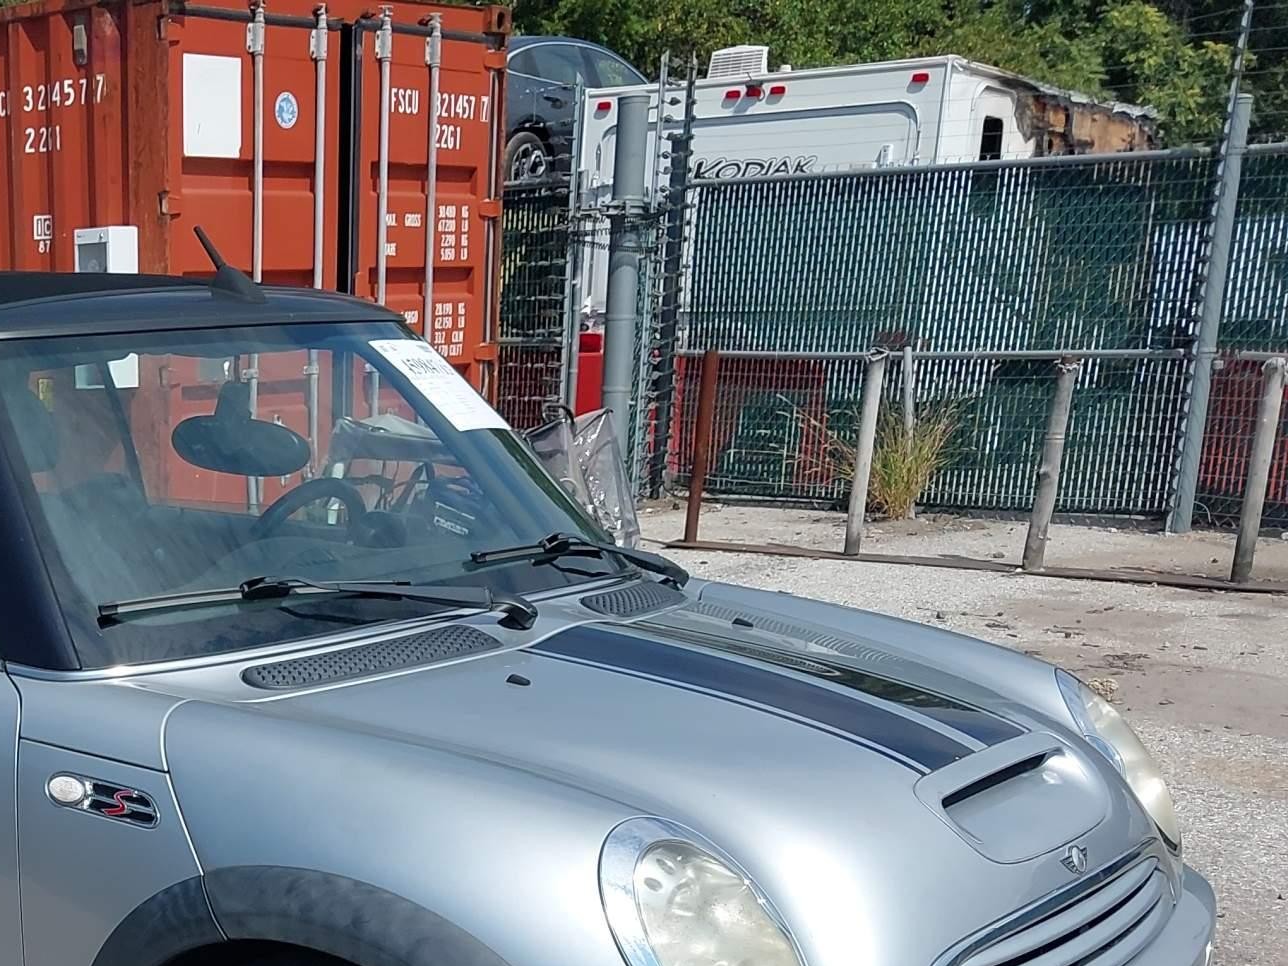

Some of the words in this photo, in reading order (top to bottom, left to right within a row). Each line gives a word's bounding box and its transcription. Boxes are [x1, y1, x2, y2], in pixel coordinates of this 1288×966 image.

[391, 87, 419, 115] FSCU
[435, 124, 461, 150] 22G1
[693, 155, 818, 179] KODIAK
[103, 789, 137, 816] S
